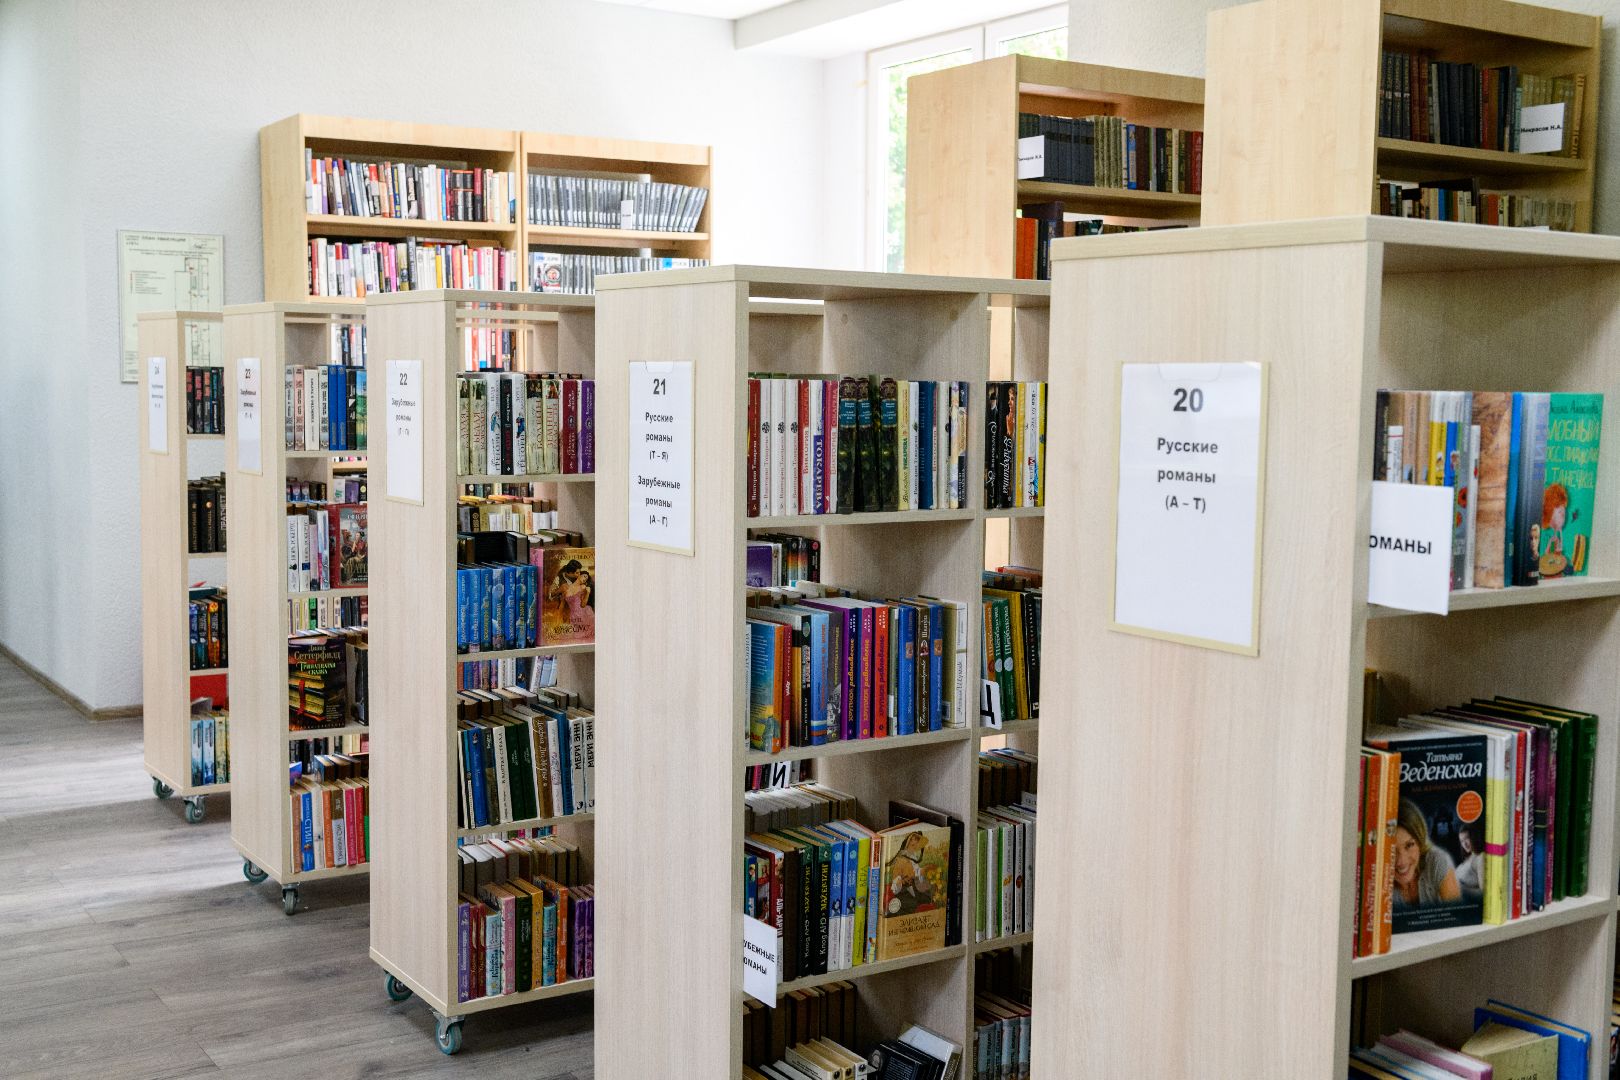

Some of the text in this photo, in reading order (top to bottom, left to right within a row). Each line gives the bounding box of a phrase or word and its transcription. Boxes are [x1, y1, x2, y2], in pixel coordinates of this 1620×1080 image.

[399, 372, 408, 386] 22
[653, 378, 667, 396] 21
[1172, 387, 1204, 413] 20
[645, 411, 674, 424] Русские
[645, 432, 673, 443] романы
[1156, 436, 1219, 455] Русские
[637, 475, 681, 490] Зарубежные
[815, 438, 824, 509] ТОКАРЕВА
[1156, 467, 1217, 484] романы
[645, 496, 673, 509] романы
[1164, 494, 1179, 511] (А
[1192, 496, 1207, 514] Т)
[1426, 751, 1464, 764] Татьяна
[1399, 760, 1483, 784] Веденская
[304, 818, 313, 843] СТИЛ
[1384, 843, 1396, 924] Веденская
[1366, 863, 1376, 932] Веденская
